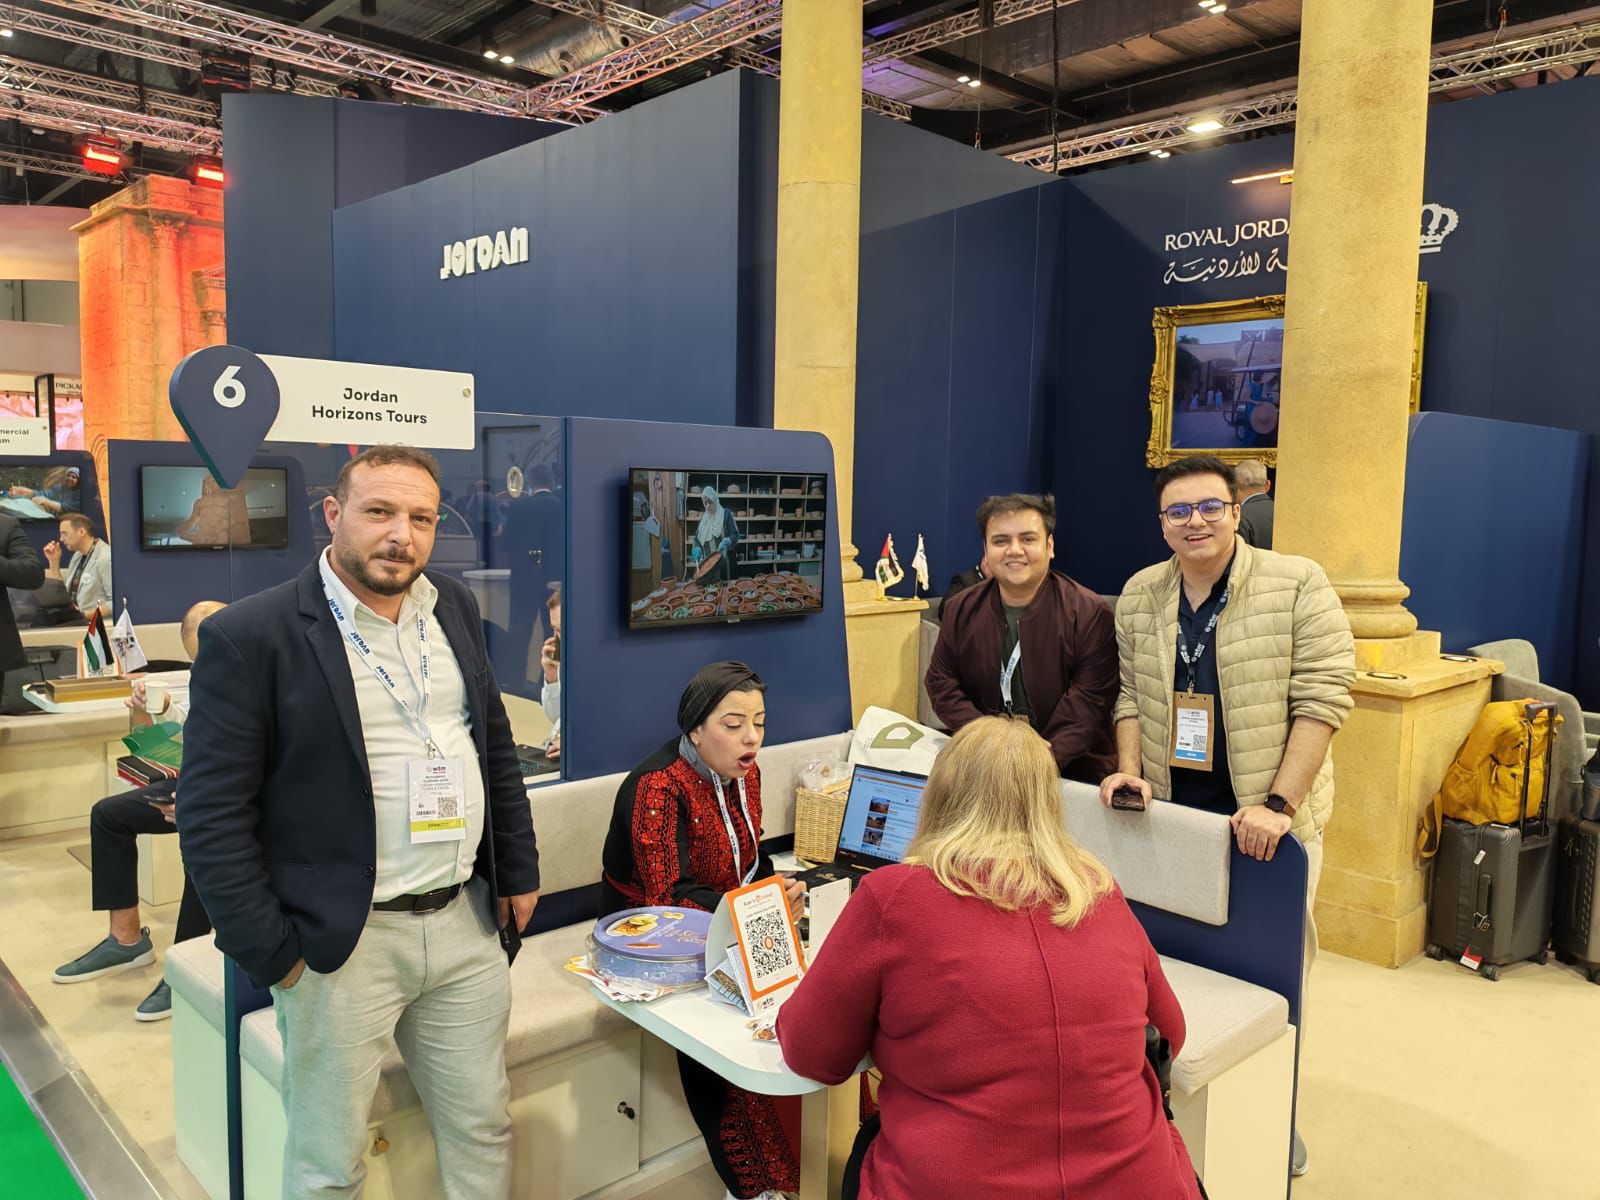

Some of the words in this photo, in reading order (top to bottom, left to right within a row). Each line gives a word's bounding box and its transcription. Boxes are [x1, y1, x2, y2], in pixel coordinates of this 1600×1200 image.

[1164, 227, 1228, 251] ROYAL
[1225, 218, 1290, 247] JORD
[213, 365, 246, 408] 6
[343, 387, 399, 403] Jordan
[311, 405, 383, 422] Horizons
[386, 410, 428, 424] Tours
